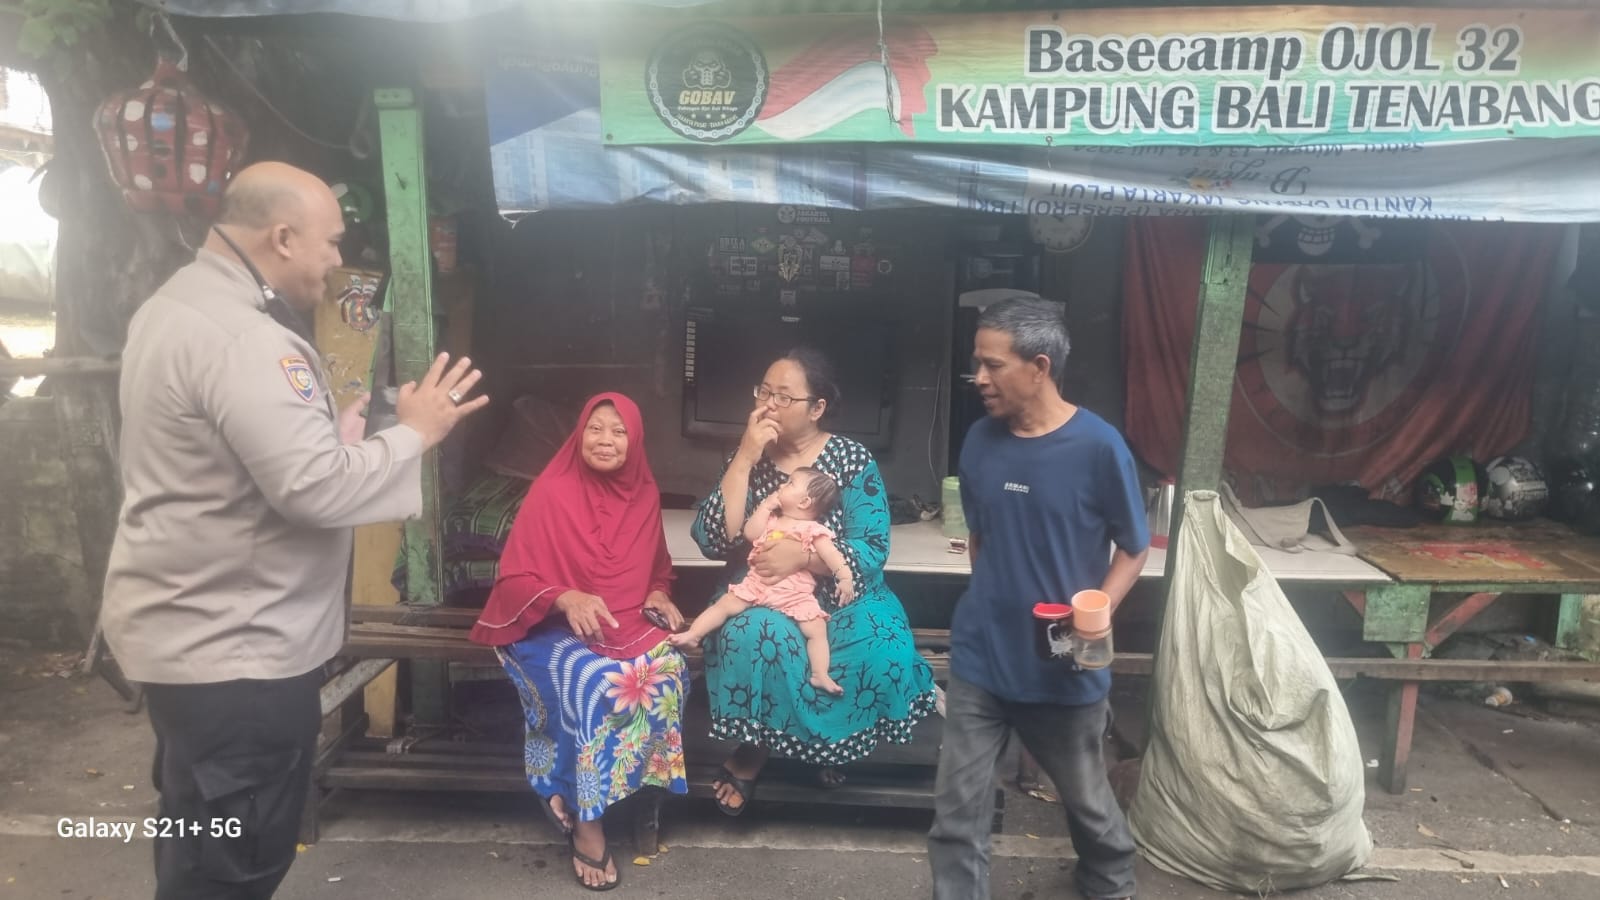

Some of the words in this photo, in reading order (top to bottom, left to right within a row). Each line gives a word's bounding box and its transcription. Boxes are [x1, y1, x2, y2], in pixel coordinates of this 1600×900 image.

[1028, 29, 1302, 81] Basecamp
[1321, 26, 1440, 71] OJOL
[1457, 27, 1520, 71] 32
[679, 90, 736, 105] GOBAV
[941, 86, 1195, 129] KAMPUNG
[1216, 85, 1331, 128] BALI
[1350, 82, 1600, 128] TENABANG
[1046, 183, 1115, 201] PLUIT
